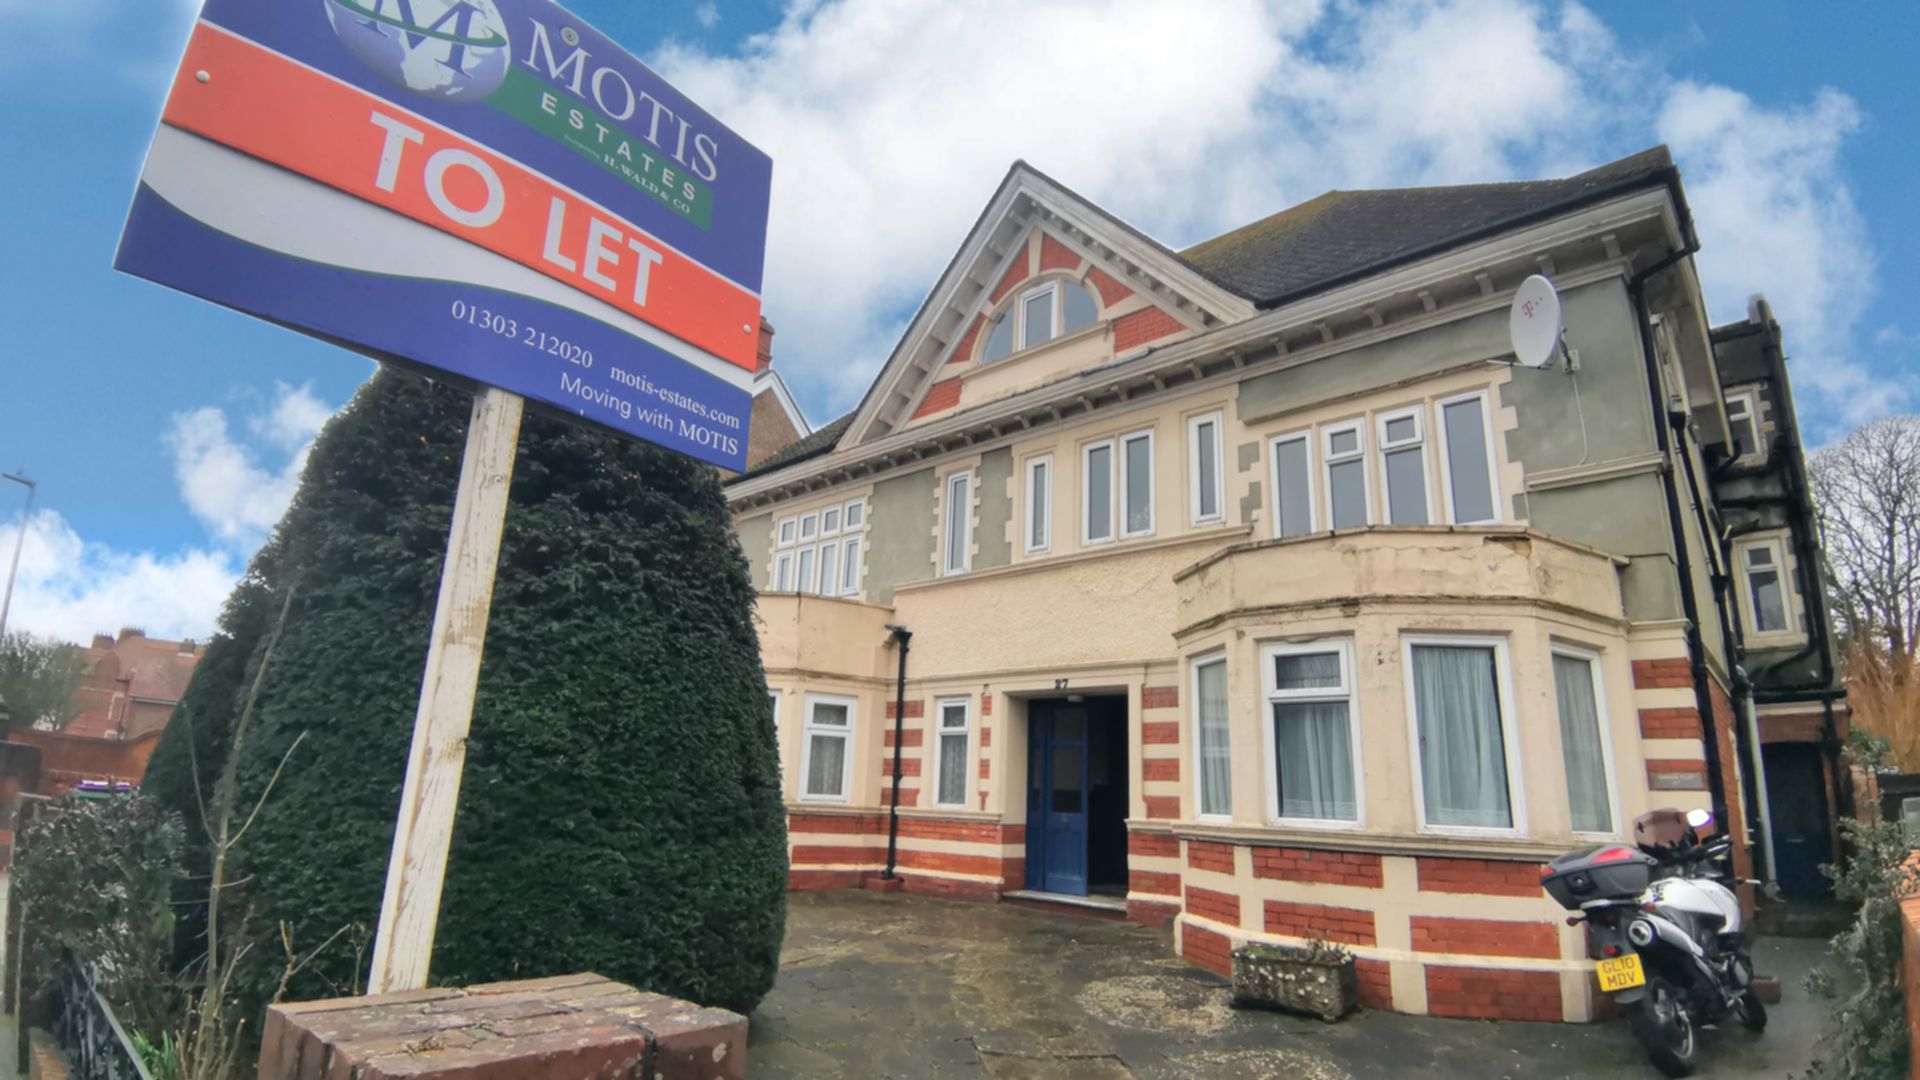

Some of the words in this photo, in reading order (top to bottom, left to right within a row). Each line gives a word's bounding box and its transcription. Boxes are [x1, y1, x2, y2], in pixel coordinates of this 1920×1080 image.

[521, 17, 719, 183] MOTIS
[541, 91, 695, 201] ESTATES
[370, 110, 506, 228] TO
[542, 196, 663, 307] LET
[621, 163, 658, 193] WALD
[673, 198, 691, 214] CO
[451, 300, 517, 338] 01303
[523, 327, 593, 368] 212020
[560, 372, 632, 420] Moving
[636, 407, 674, 433] with
[678, 419, 739, 456] MOTIS
[610, 366, 740, 430] motis-estates.com
[1055, 679, 1068, 690] 27
[1602, 957, 1635, 973] GL10
[1607, 971, 1635, 987] MDV
